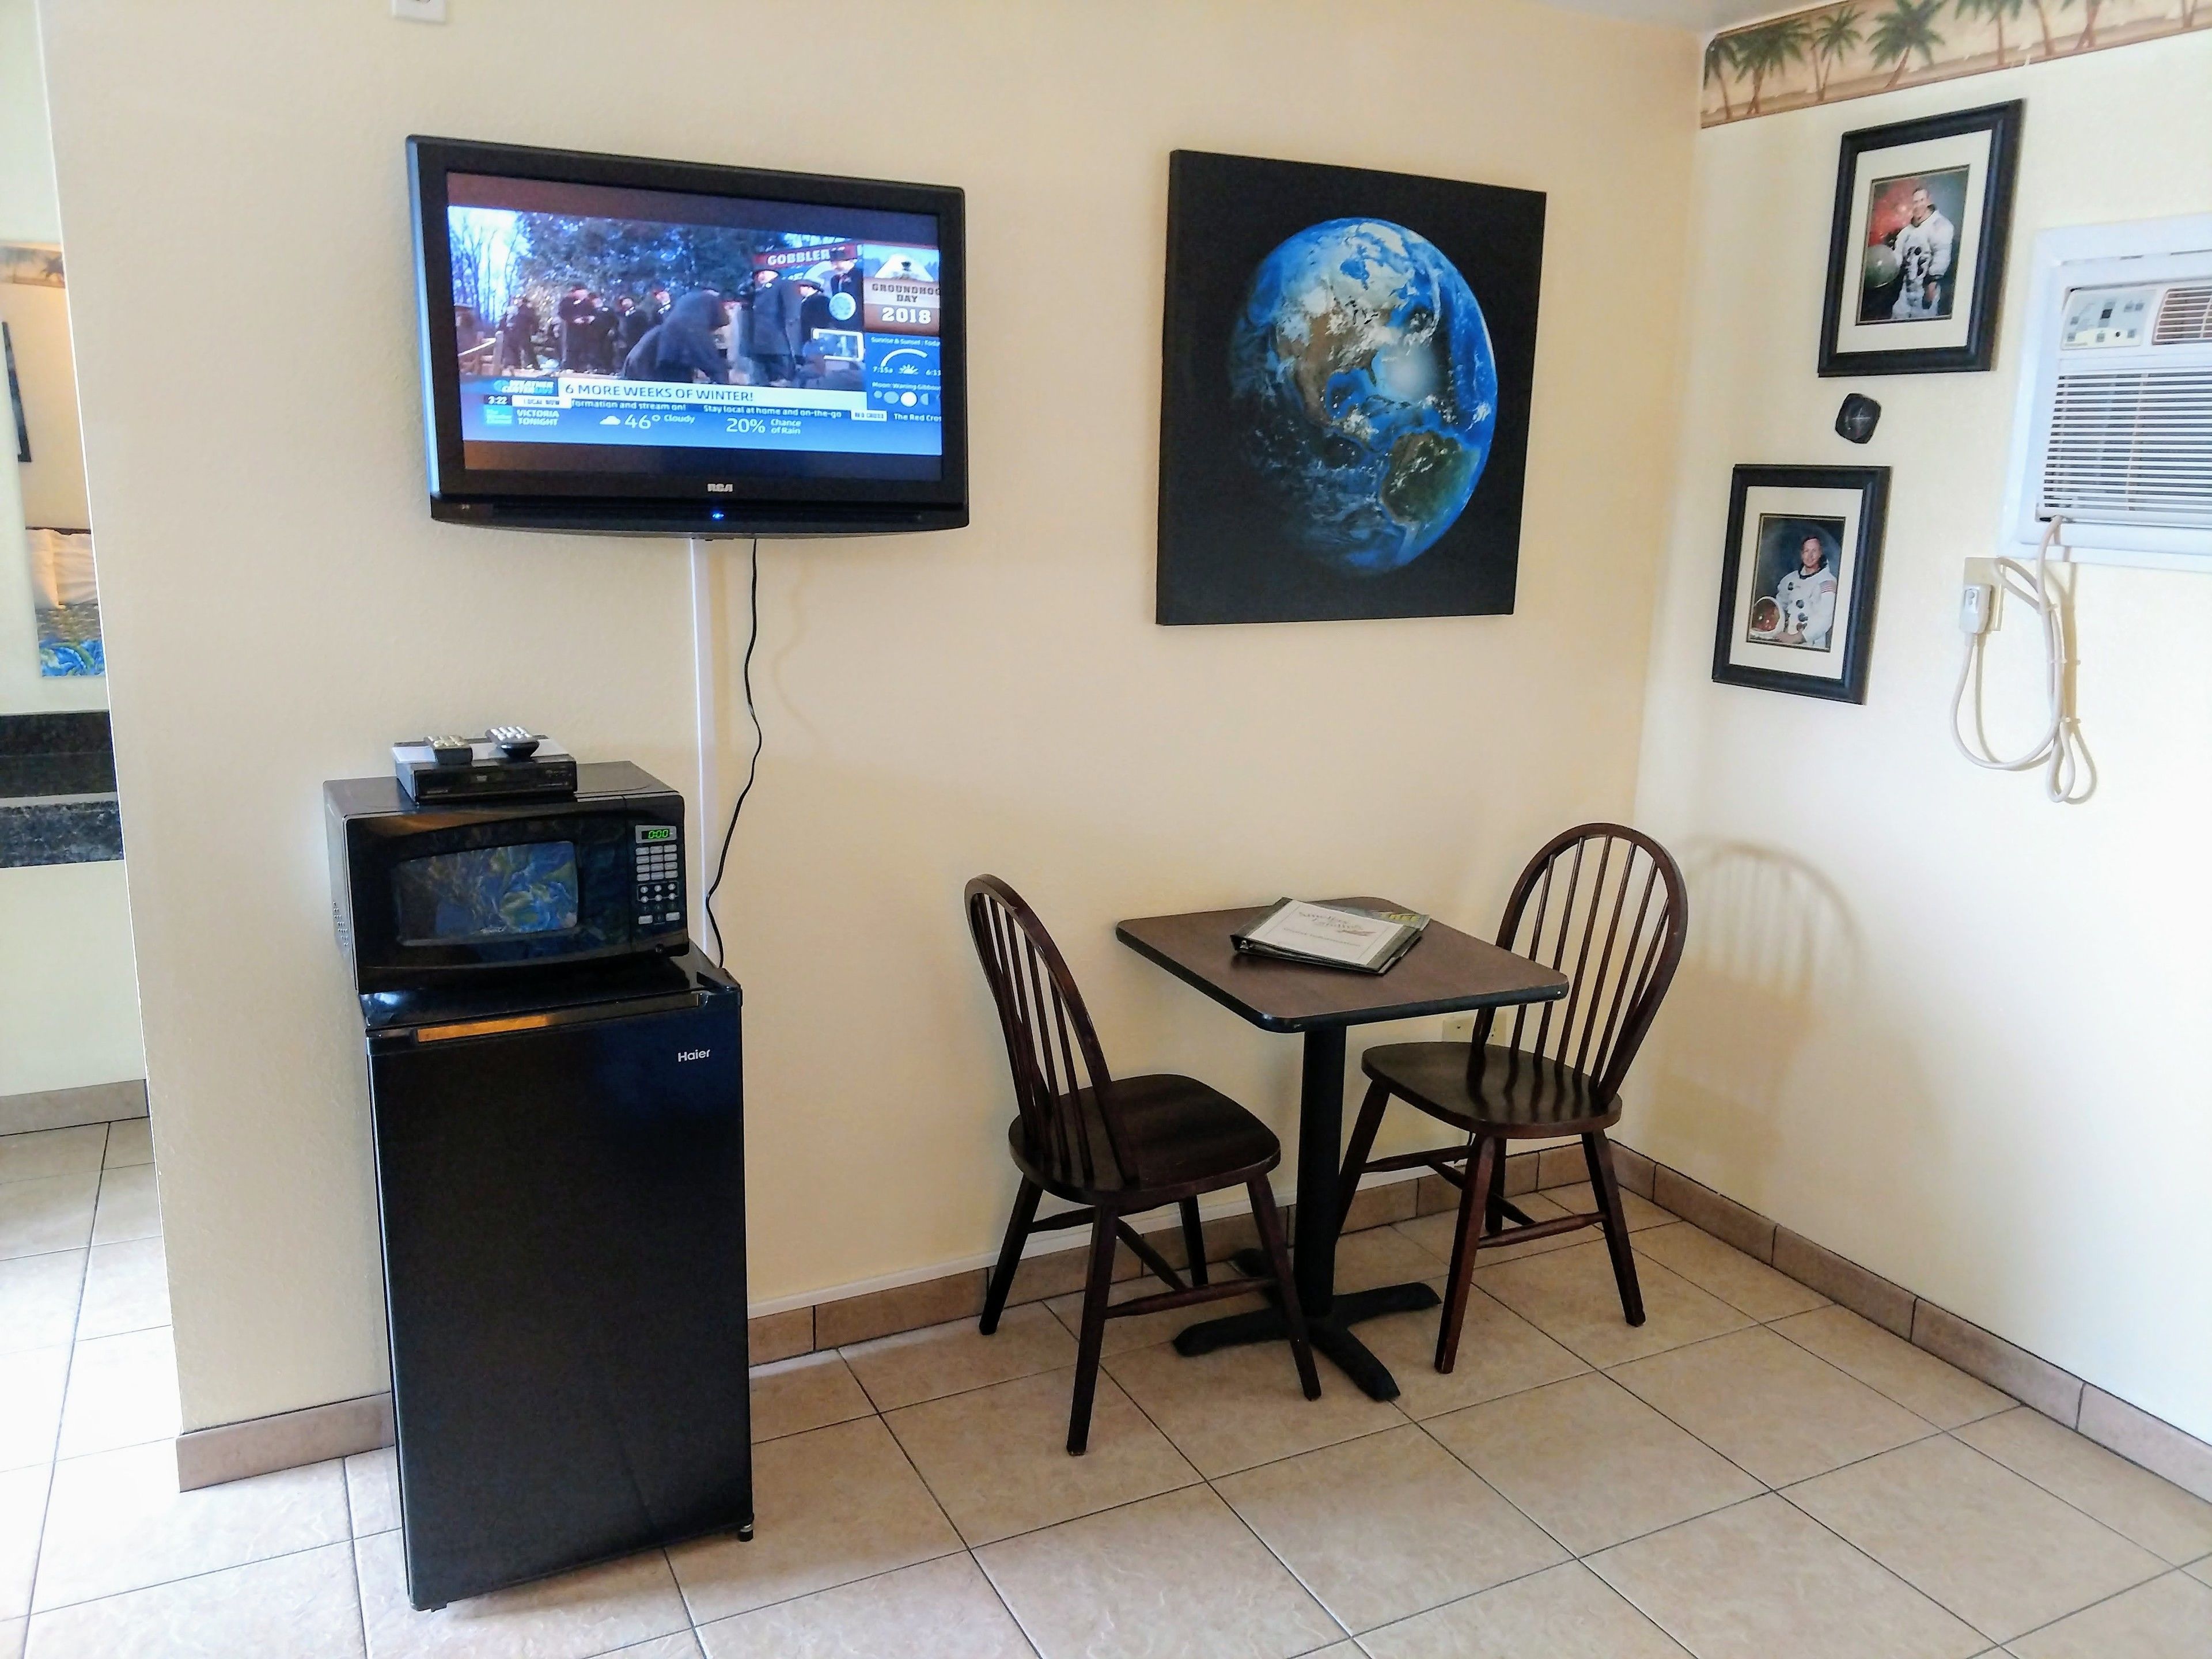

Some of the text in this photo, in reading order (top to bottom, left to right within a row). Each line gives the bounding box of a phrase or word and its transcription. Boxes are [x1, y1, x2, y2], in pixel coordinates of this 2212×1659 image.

[767, 249, 831, 266] GOBBLER
[896, 294, 918, 302] DAY
[882, 307, 931, 324] 2018
[565, 384, 574, 393] 6
[578, 385, 620, 395] MORE
[624, 387, 672, 397] WEEKS
[676, 389, 693, 398] OF
[696, 389, 753, 402] WINTER!
[619, 402, 637, 410] and
[703, 405, 722, 414] Stay
[724, 406, 744, 414] local
[517, 409, 560, 418] VICTORIA
[517, 417, 558, 426] TONIGHT
[664, 414, 696, 424] Cloudy
[770, 418, 802, 426] Chance
[726, 418, 766, 433] 20%
[781, 427, 801, 435] Rain
[707, 483, 733, 492] RCA
[648, 830, 669, 839] 0:00
[677, 1049, 711, 1062] Haier
